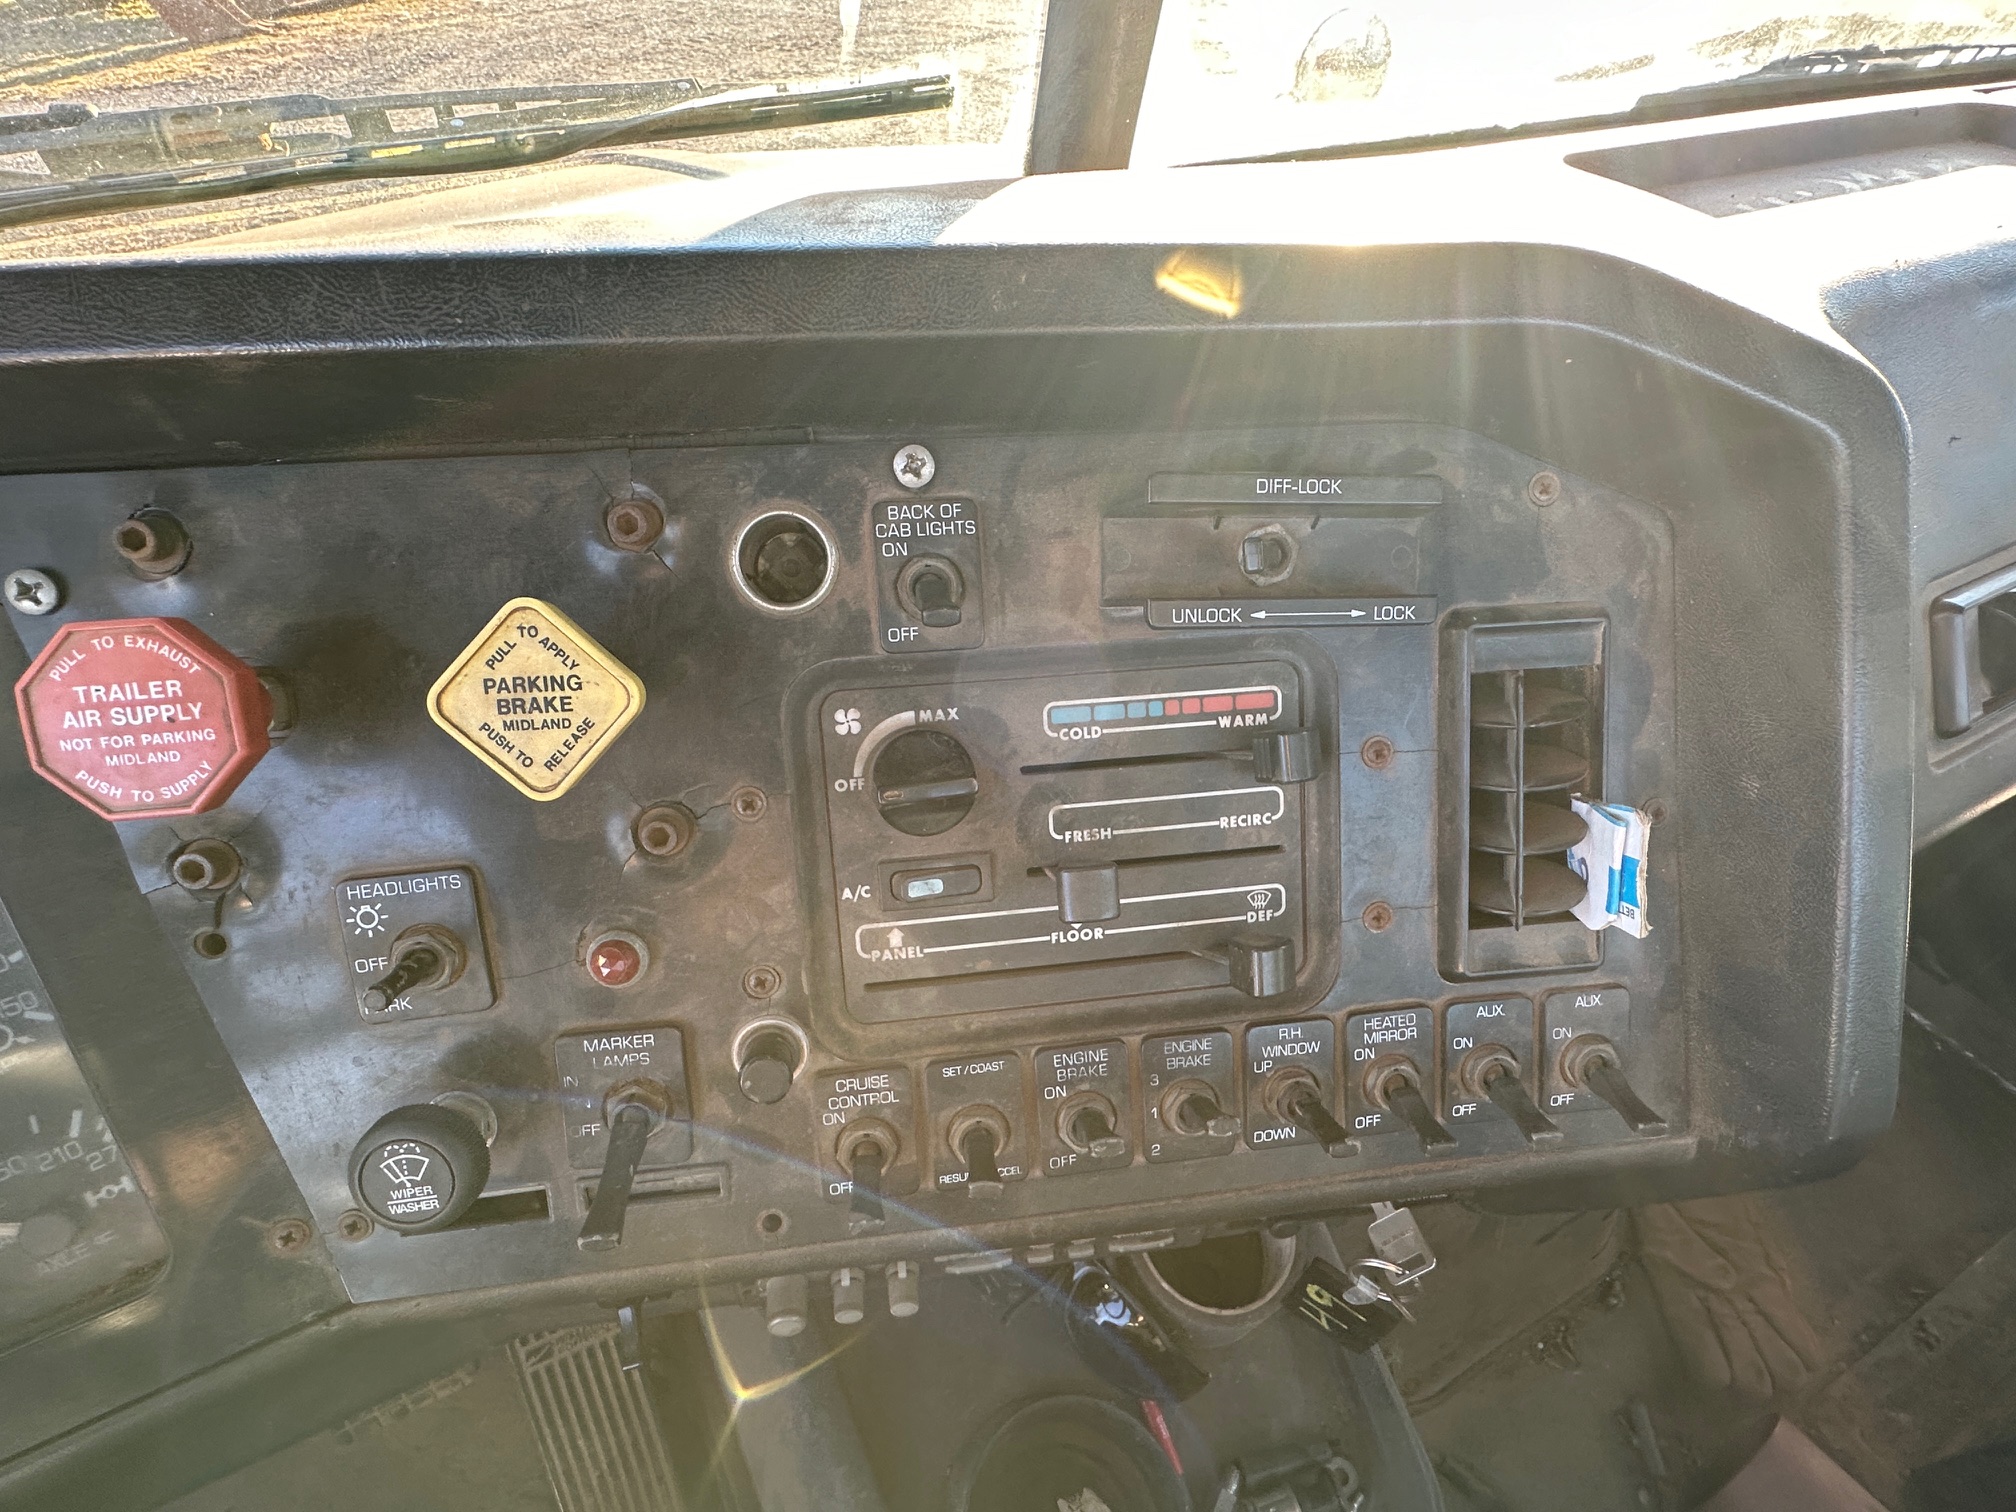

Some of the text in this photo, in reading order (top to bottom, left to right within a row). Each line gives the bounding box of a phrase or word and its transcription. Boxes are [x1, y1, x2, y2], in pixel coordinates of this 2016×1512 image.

[1256, 478, 1343, 495] DIFF-LOCK
[887, 503, 962, 521] BACK OF
[875, 520, 976, 538] CAB LIGHTS
[882, 542, 908, 557] ON
[1172, 607, 1242, 624] UNLOCK
[1373, 605, 1416, 621] LOCK
[888, 626, 919, 643] OFF
[485, 623, 580, 671] PULL TO APPLY
[49, 635, 201, 682] PULL TO EXHAUST
[72, 679, 183, 704] TRAILER
[483, 674, 583, 695] PARKING
[496, 696, 574, 716] BRAKE
[63, 702, 202, 729] AIR SUPPLY
[919, 707, 960, 723] MAX
[502, 718, 572, 732] MIDLAND
[1059, 713, 1268, 741] COLD WARM
[60, 728, 216, 752] NOT FOR PARKING
[479, 717, 596, 772] PUSH TO RELEASE
[105, 751, 181, 767] MIDLAND
[75, 760, 213, 802] PUSH TO SUPPLY
[834, 778, 865, 792] OFF
[1064, 812, 1273, 844] FRESH RECIRC
[346, 874, 462, 900] HEADLIGHTS
[841, 885, 872, 902] A/C
[871, 909, 1275, 962] PANEL FLOOR DEF
[354, 957, 389, 973] OFF
[364, 996, 413, 1015] RK
[1363, 1013, 1416, 1031] HEATED
[1278, 1027, 1304, 1040] R.H.
[1363, 1027, 1417, 1045] MIRROR
[1552, 1027, 1572, 1040] ON
[583, 1033, 655, 1052] MARKER
[1164, 1037, 1212, 1054] ENGINE
[1262, 1040, 1321, 1058] WINDOW
[1453, 1037, 1473, 1050] ON
[592, 1052, 650, 1070] LAMPS
[1053, 1048, 1109, 1068] ENGINE
[1166, 1053, 1211, 1070] BRAKE
[1354, 1047, 1376, 1061] ON
[1057, 1063, 1108, 1082] BRAKE
[1253, 1060, 1273, 1073] UP
[835, 1074, 890, 1093] CRUISE
[1150, 1074, 1159, 1086] 3
[828, 1090, 899, 1111] CONTROL
[1044, 1085, 1067, 1100] ON
[1550, 1093, 1575, 1107] OFF
[822, 1111, 846, 1126] ON
[1151, 1107, 1158, 1119] 1
[1452, 1103, 1477, 1117] OFF
[1355, 1114, 1382, 1129] OFF
[570, 1123, 601, 1138] OFF
[1253, 1126, 1296, 1143] DOWN
[1151, 1144, 1161, 1156] 2
[1049, 1153, 1077, 1169] OFF
[390, 1185, 434, 1200] WIPER
[388, 1199, 440, 1215] WASHER
